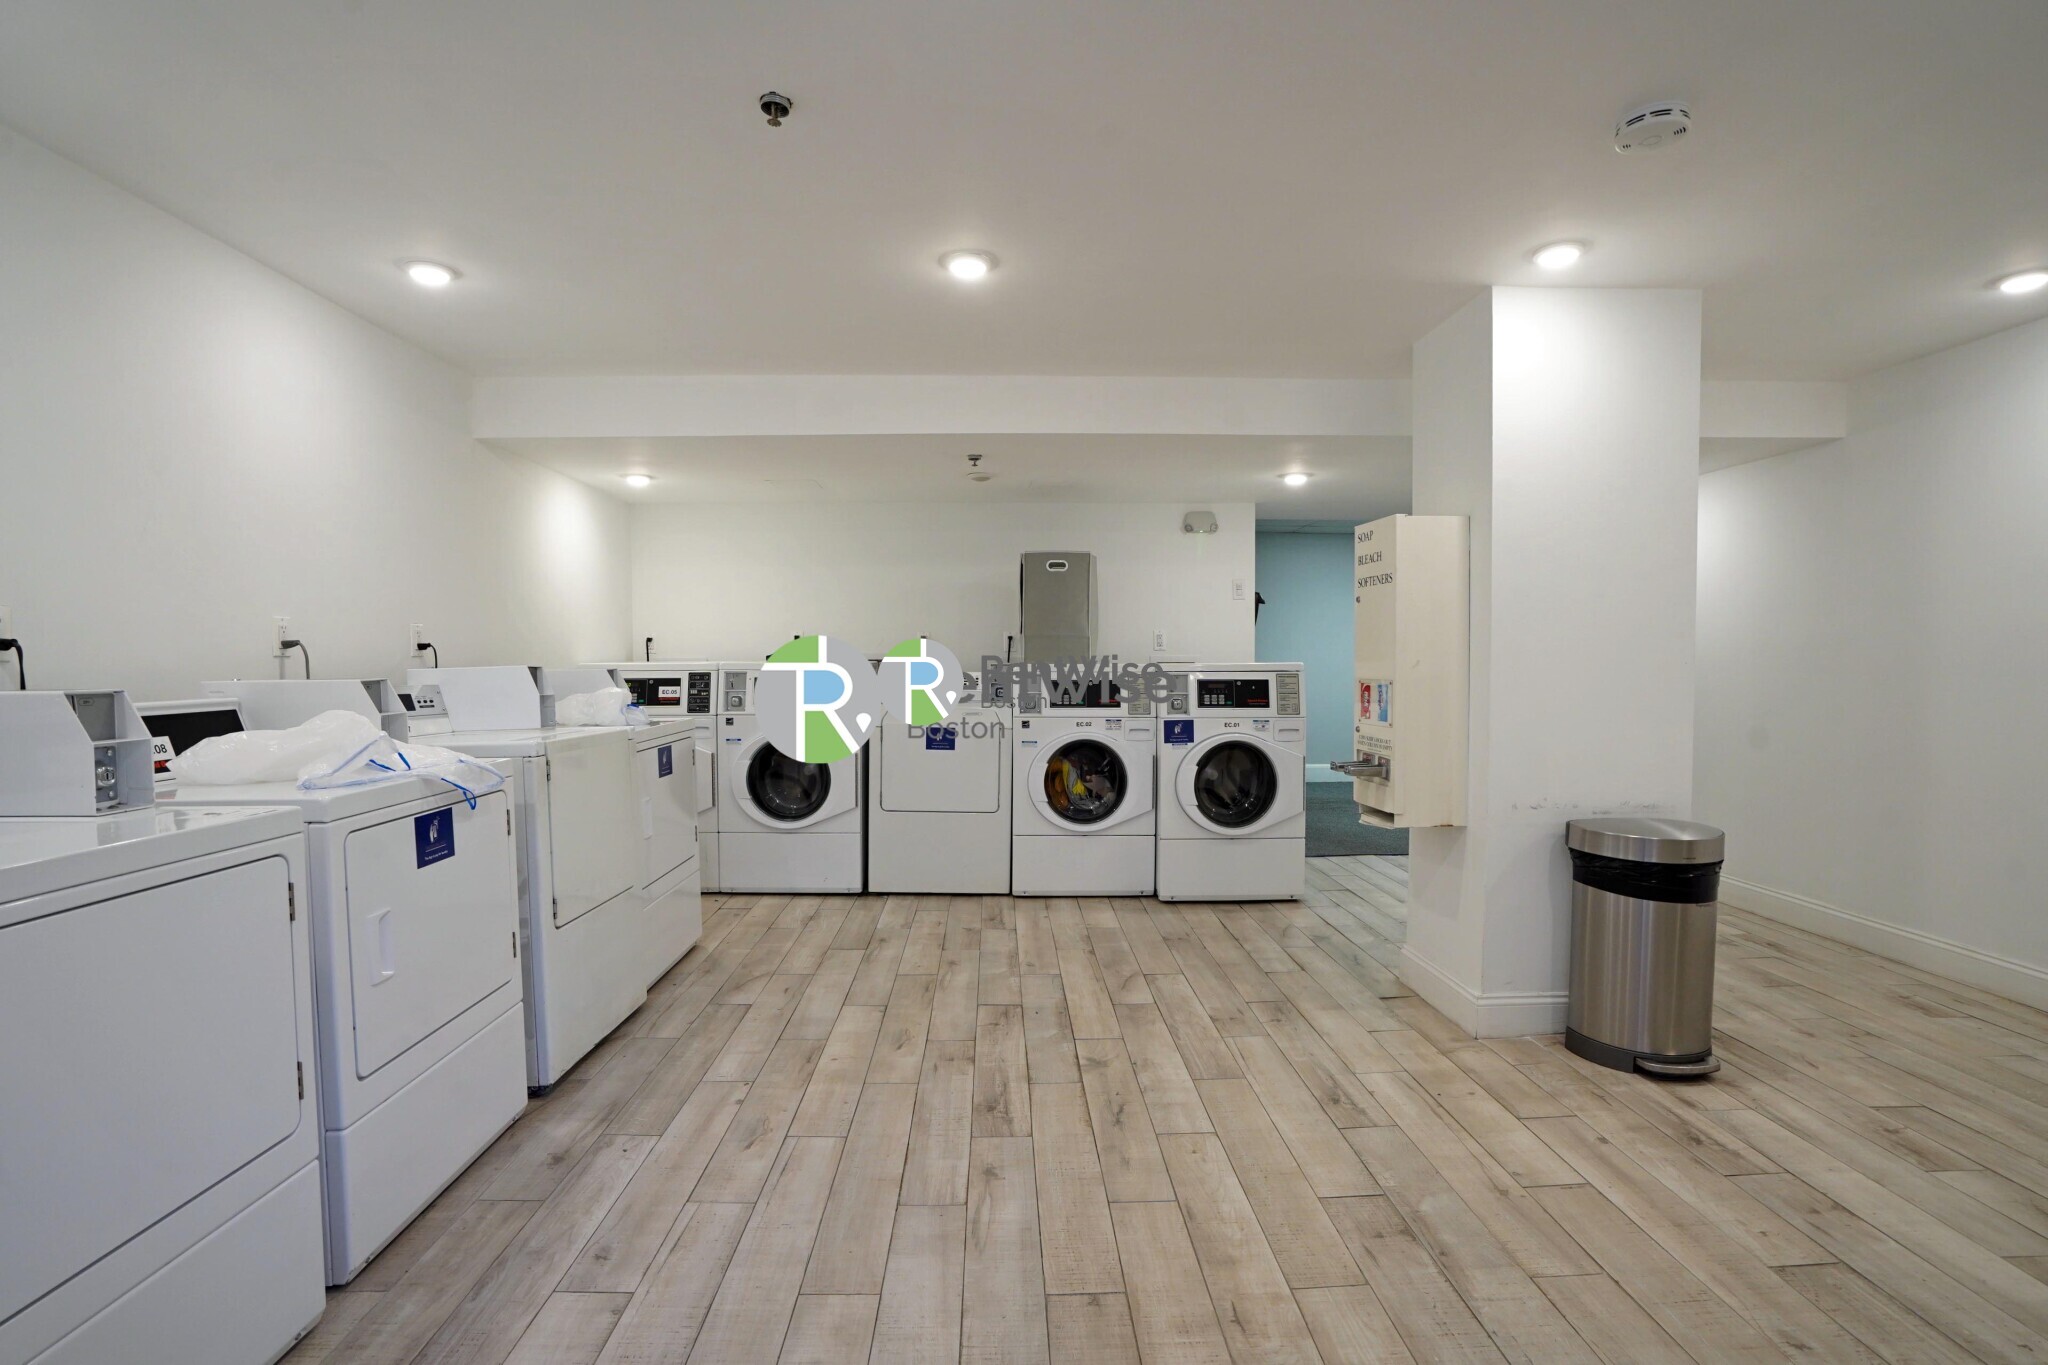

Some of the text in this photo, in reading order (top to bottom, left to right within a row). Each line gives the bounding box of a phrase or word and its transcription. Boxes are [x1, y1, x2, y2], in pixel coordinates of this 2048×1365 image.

[1357, 530, 1374, 543] SOAP
[1357, 551, 1382, 566] BLEACH
[1357, 573, 1393, 588] SOFTENERS
